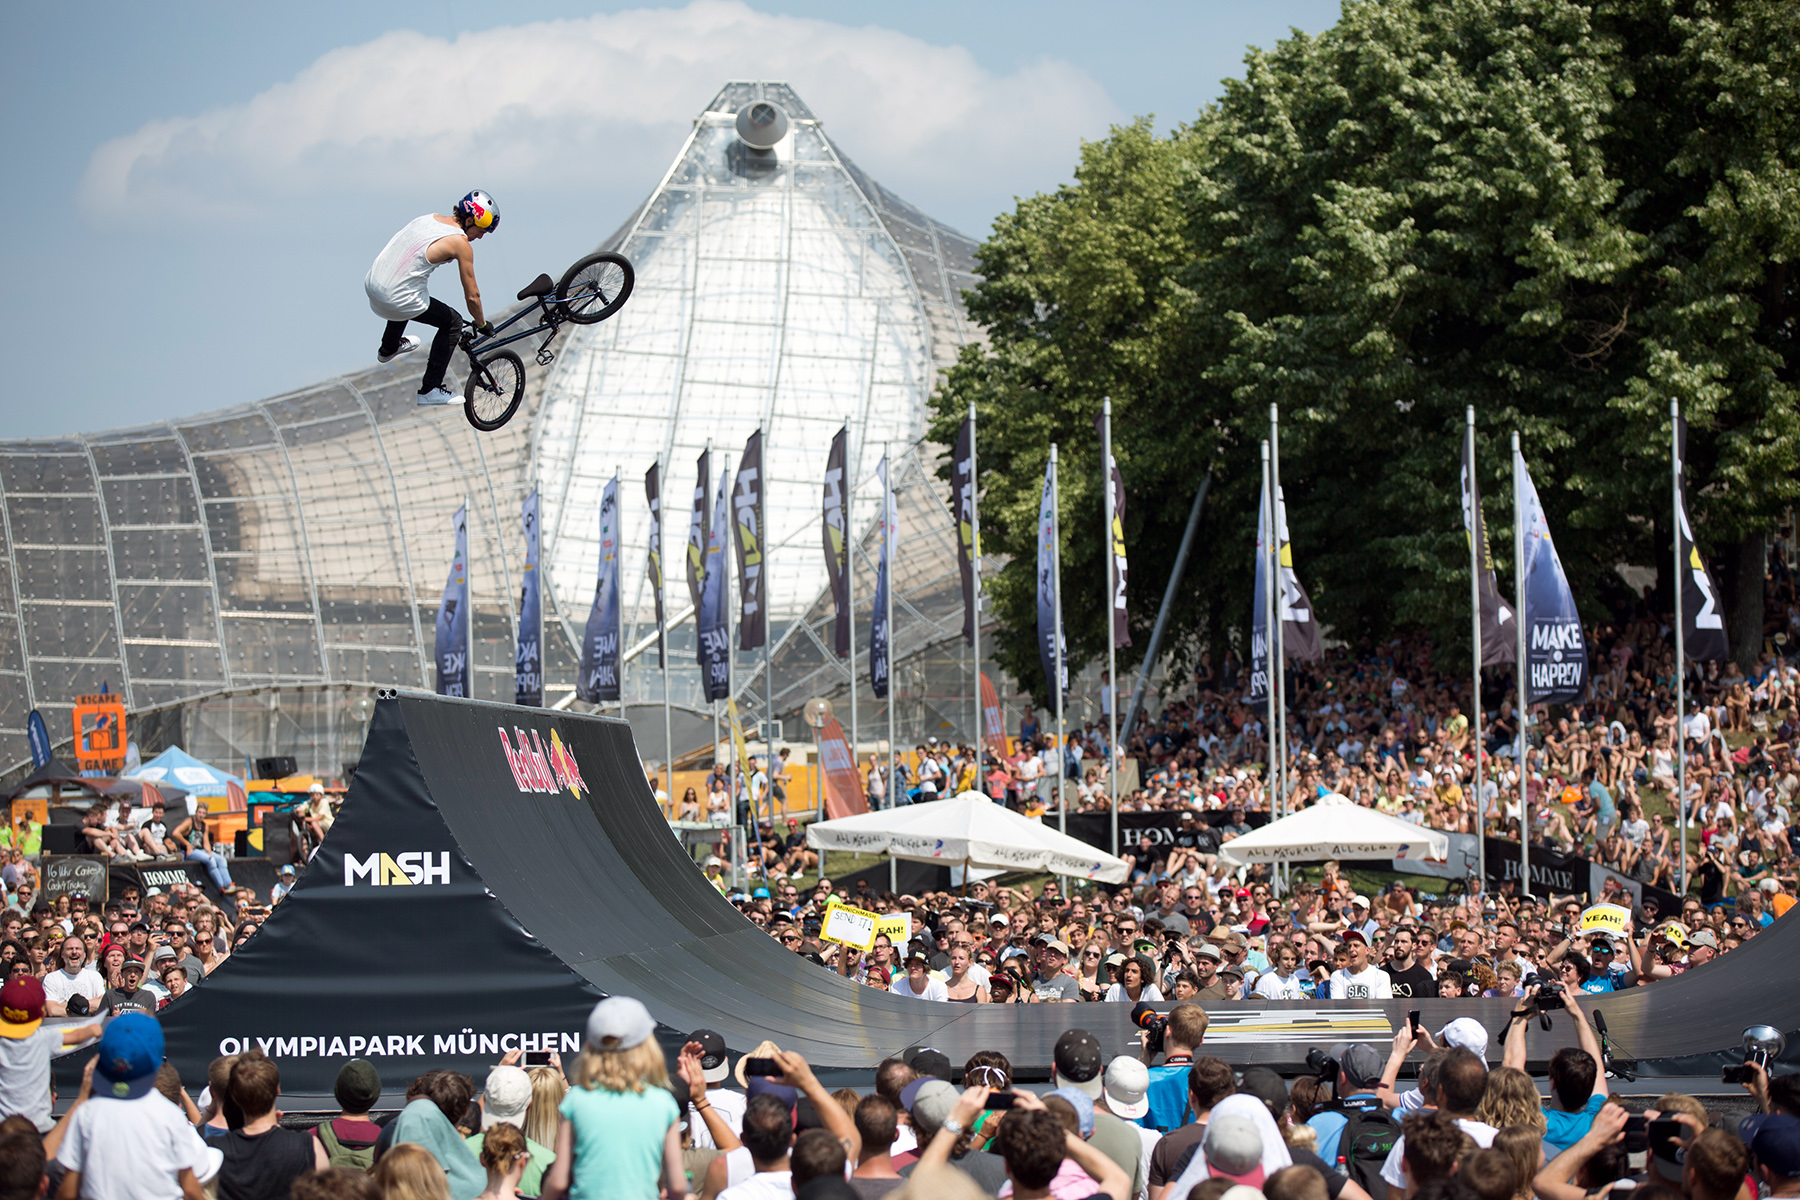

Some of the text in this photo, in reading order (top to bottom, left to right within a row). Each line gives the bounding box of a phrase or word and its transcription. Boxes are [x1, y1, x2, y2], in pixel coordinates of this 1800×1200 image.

[1531, 623, 1582, 650] MAKE
[1531, 662, 1582, 687] HAPPEN
[85, 759, 119, 770] GAME
[1247, 848, 1269, 858] ALL
[47, 864, 58, 878] 16
[344, 851, 450, 886] MASH
[143, 869, 189, 886] HOMME
[834, 911, 856, 924] SEND
[1585, 914, 1622, 925] YEAH!
[878, 926, 904, 934] EAH!
[1348, 985, 1368, 998] SLS
[219, 1028, 581, 1058] OLYMPIAPARK MÜNCHEN
